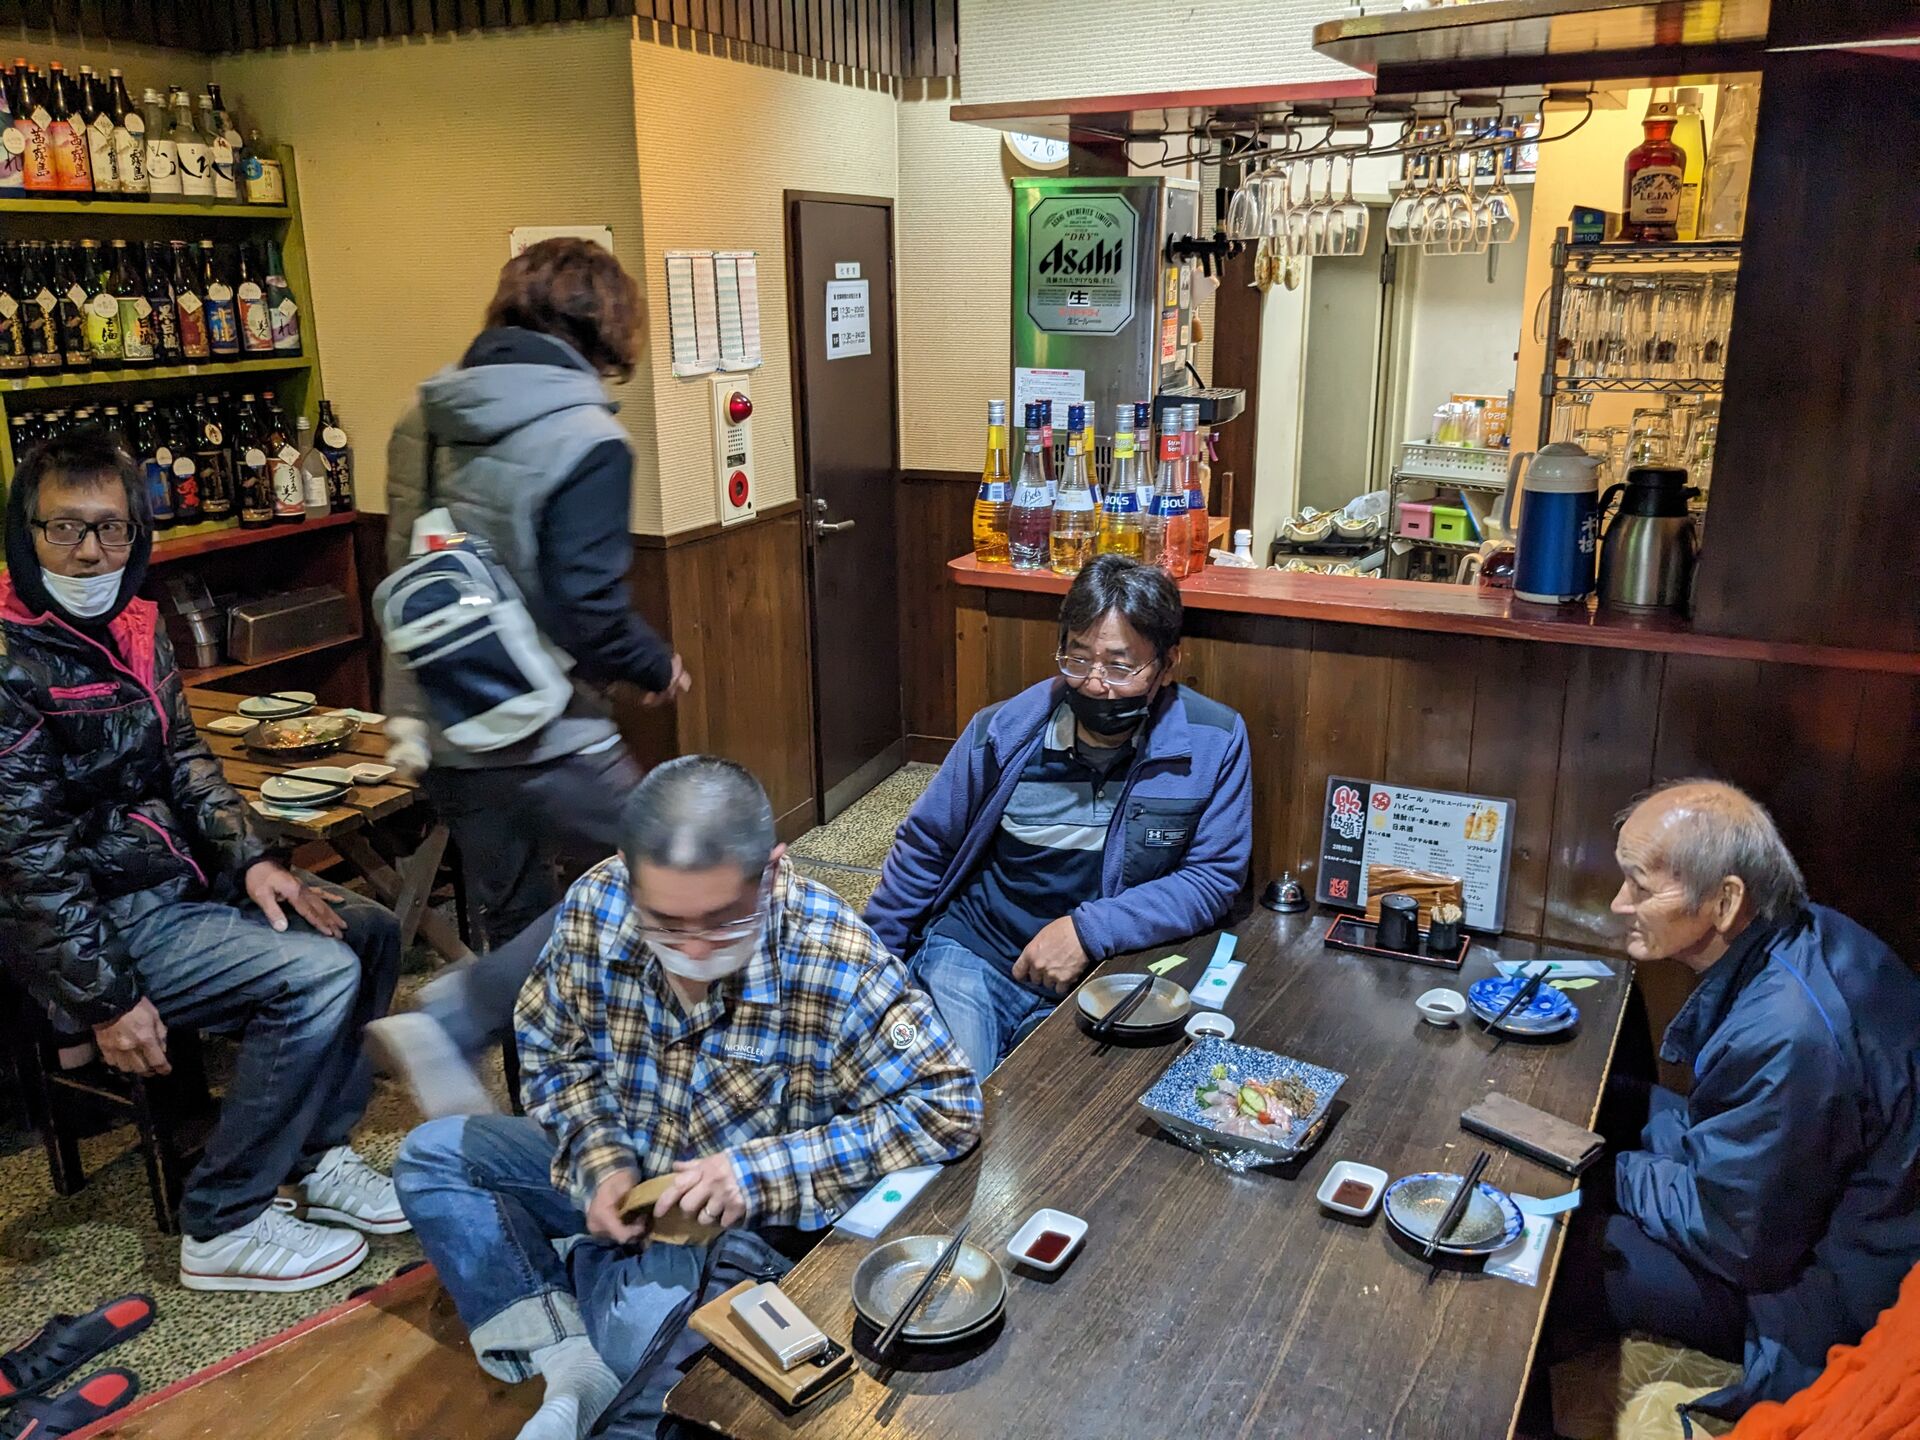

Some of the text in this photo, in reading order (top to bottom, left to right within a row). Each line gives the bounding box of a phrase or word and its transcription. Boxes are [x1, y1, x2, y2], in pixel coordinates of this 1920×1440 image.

[1047, 145, 1054, 156] 6
[1640, 191, 1674, 201] LEJAY
[1039, 239, 1123, 275] Asahi
[1069, 290, 1089, 305] 生
[1104, 495, 1130, 506] BOLS
[1161, 498, 1186, 509] BOLS
[1396, 793, 1424, 803] 生ビール
[1393, 803, 1430, 814] ハイボール
[1392, 823, 1414, 833] 日本酒
[1467, 845, 1498, 854] ソフトドリンク
